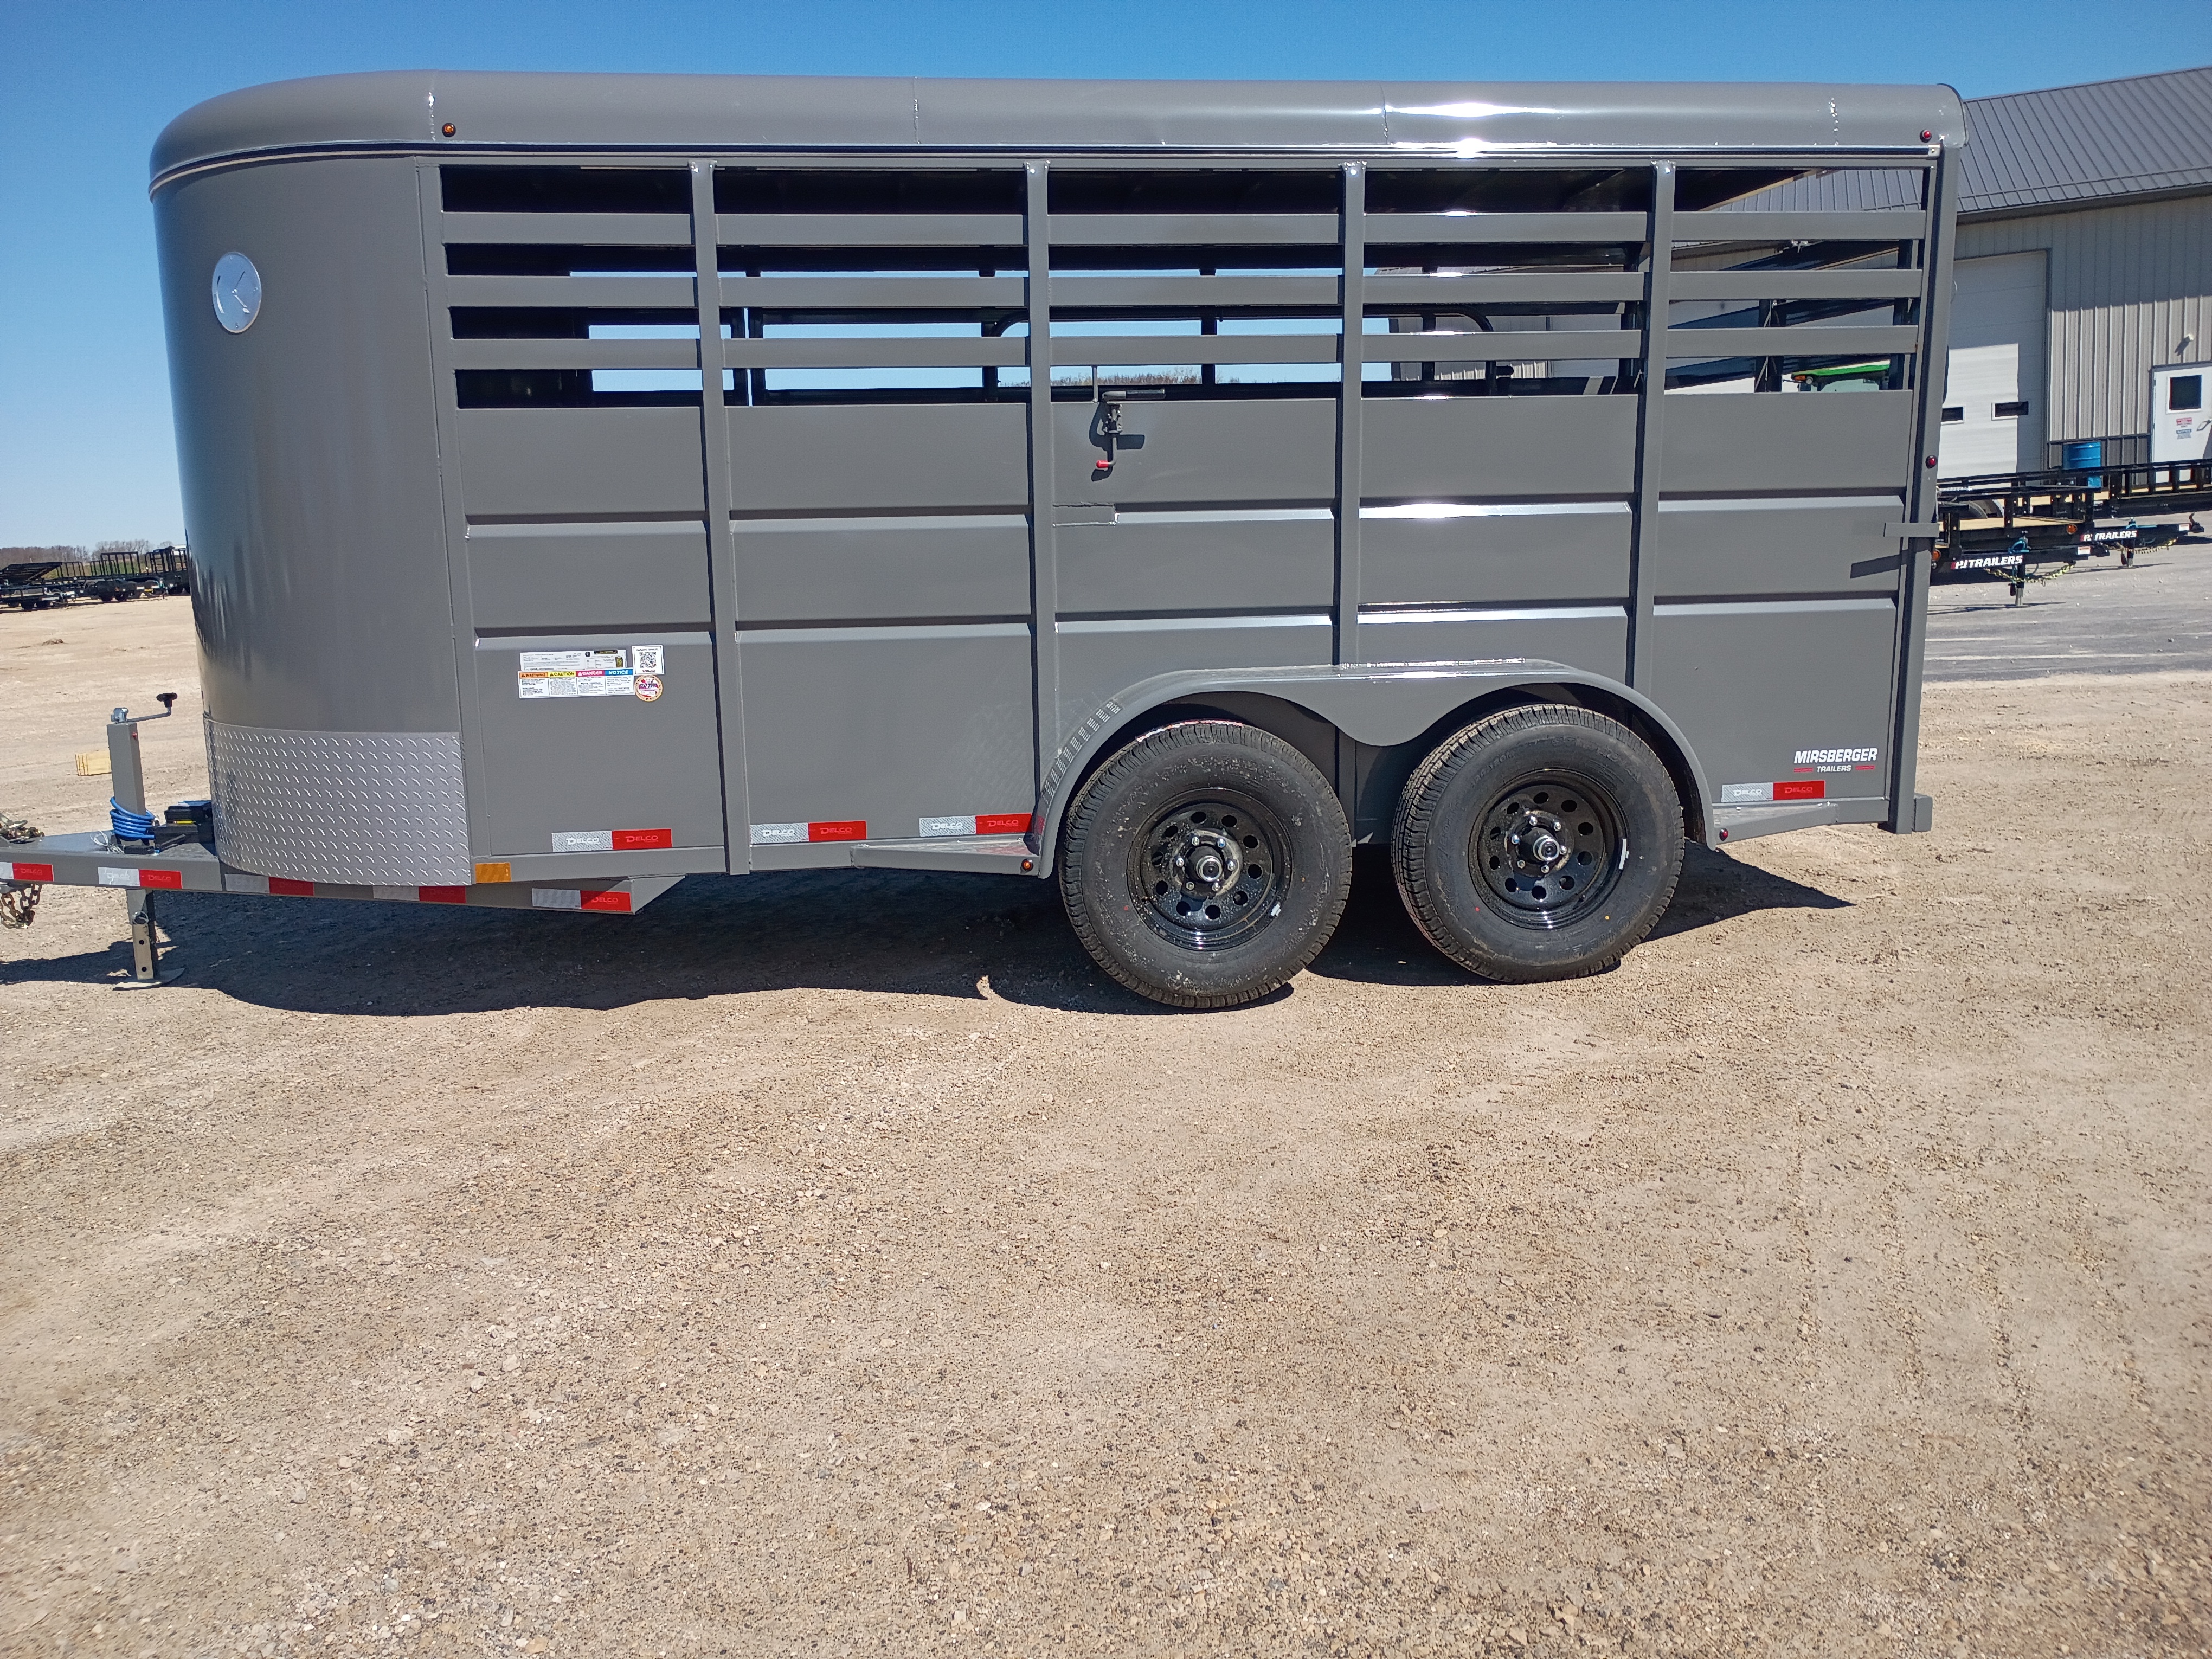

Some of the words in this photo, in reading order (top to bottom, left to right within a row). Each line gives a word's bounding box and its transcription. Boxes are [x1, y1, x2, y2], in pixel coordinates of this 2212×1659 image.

[2094, 530, 2137, 541] TRAILERS
[1955, 560, 1967, 569] PJ
[1969, 555, 2023, 568] TRAILERS
[1794, 748, 1877, 763] MIRSBERGER
[931, 822, 963, 830] DELCO
[566, 837, 600, 845] DELCO
